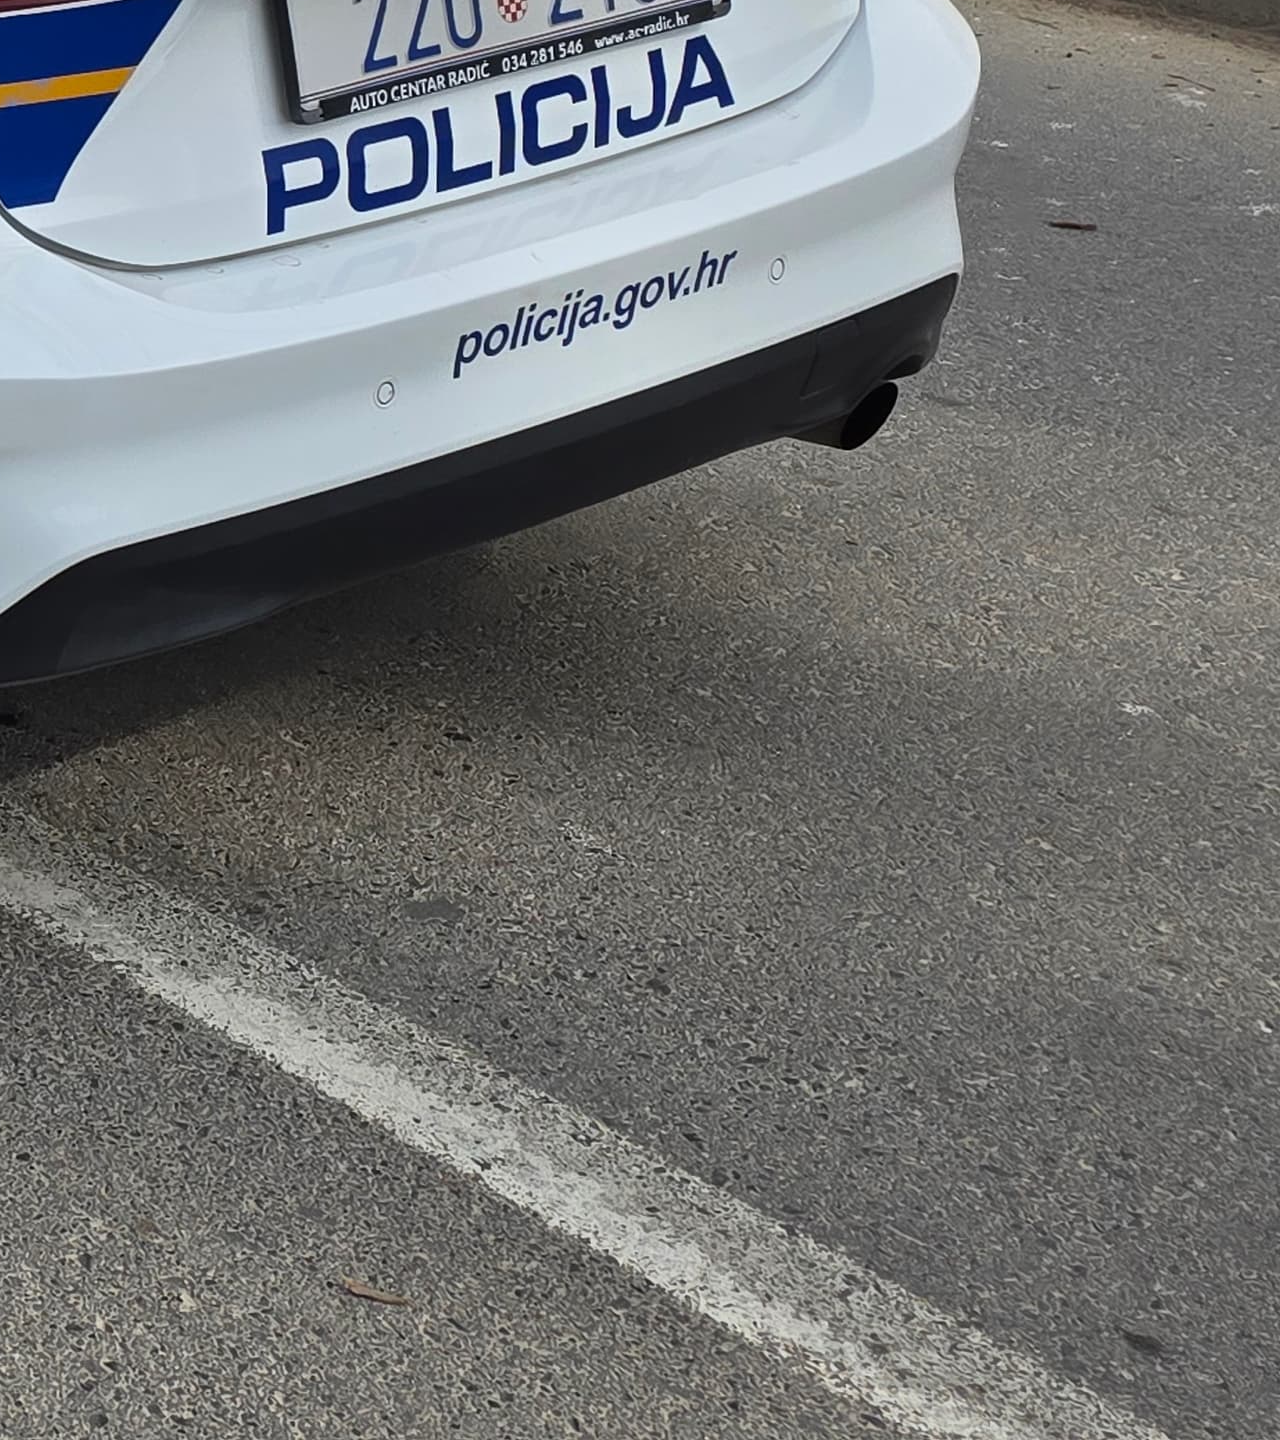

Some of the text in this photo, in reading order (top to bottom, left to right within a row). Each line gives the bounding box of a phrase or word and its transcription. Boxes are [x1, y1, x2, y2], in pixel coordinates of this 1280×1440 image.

[350, 11, 690, 113] AUTO CENTAR RADIĆ 034 281 546 www.ac-radic.hr
[261, 34, 736, 236] POLICIJA
[452, 246, 739, 378] policija.gov.hr
